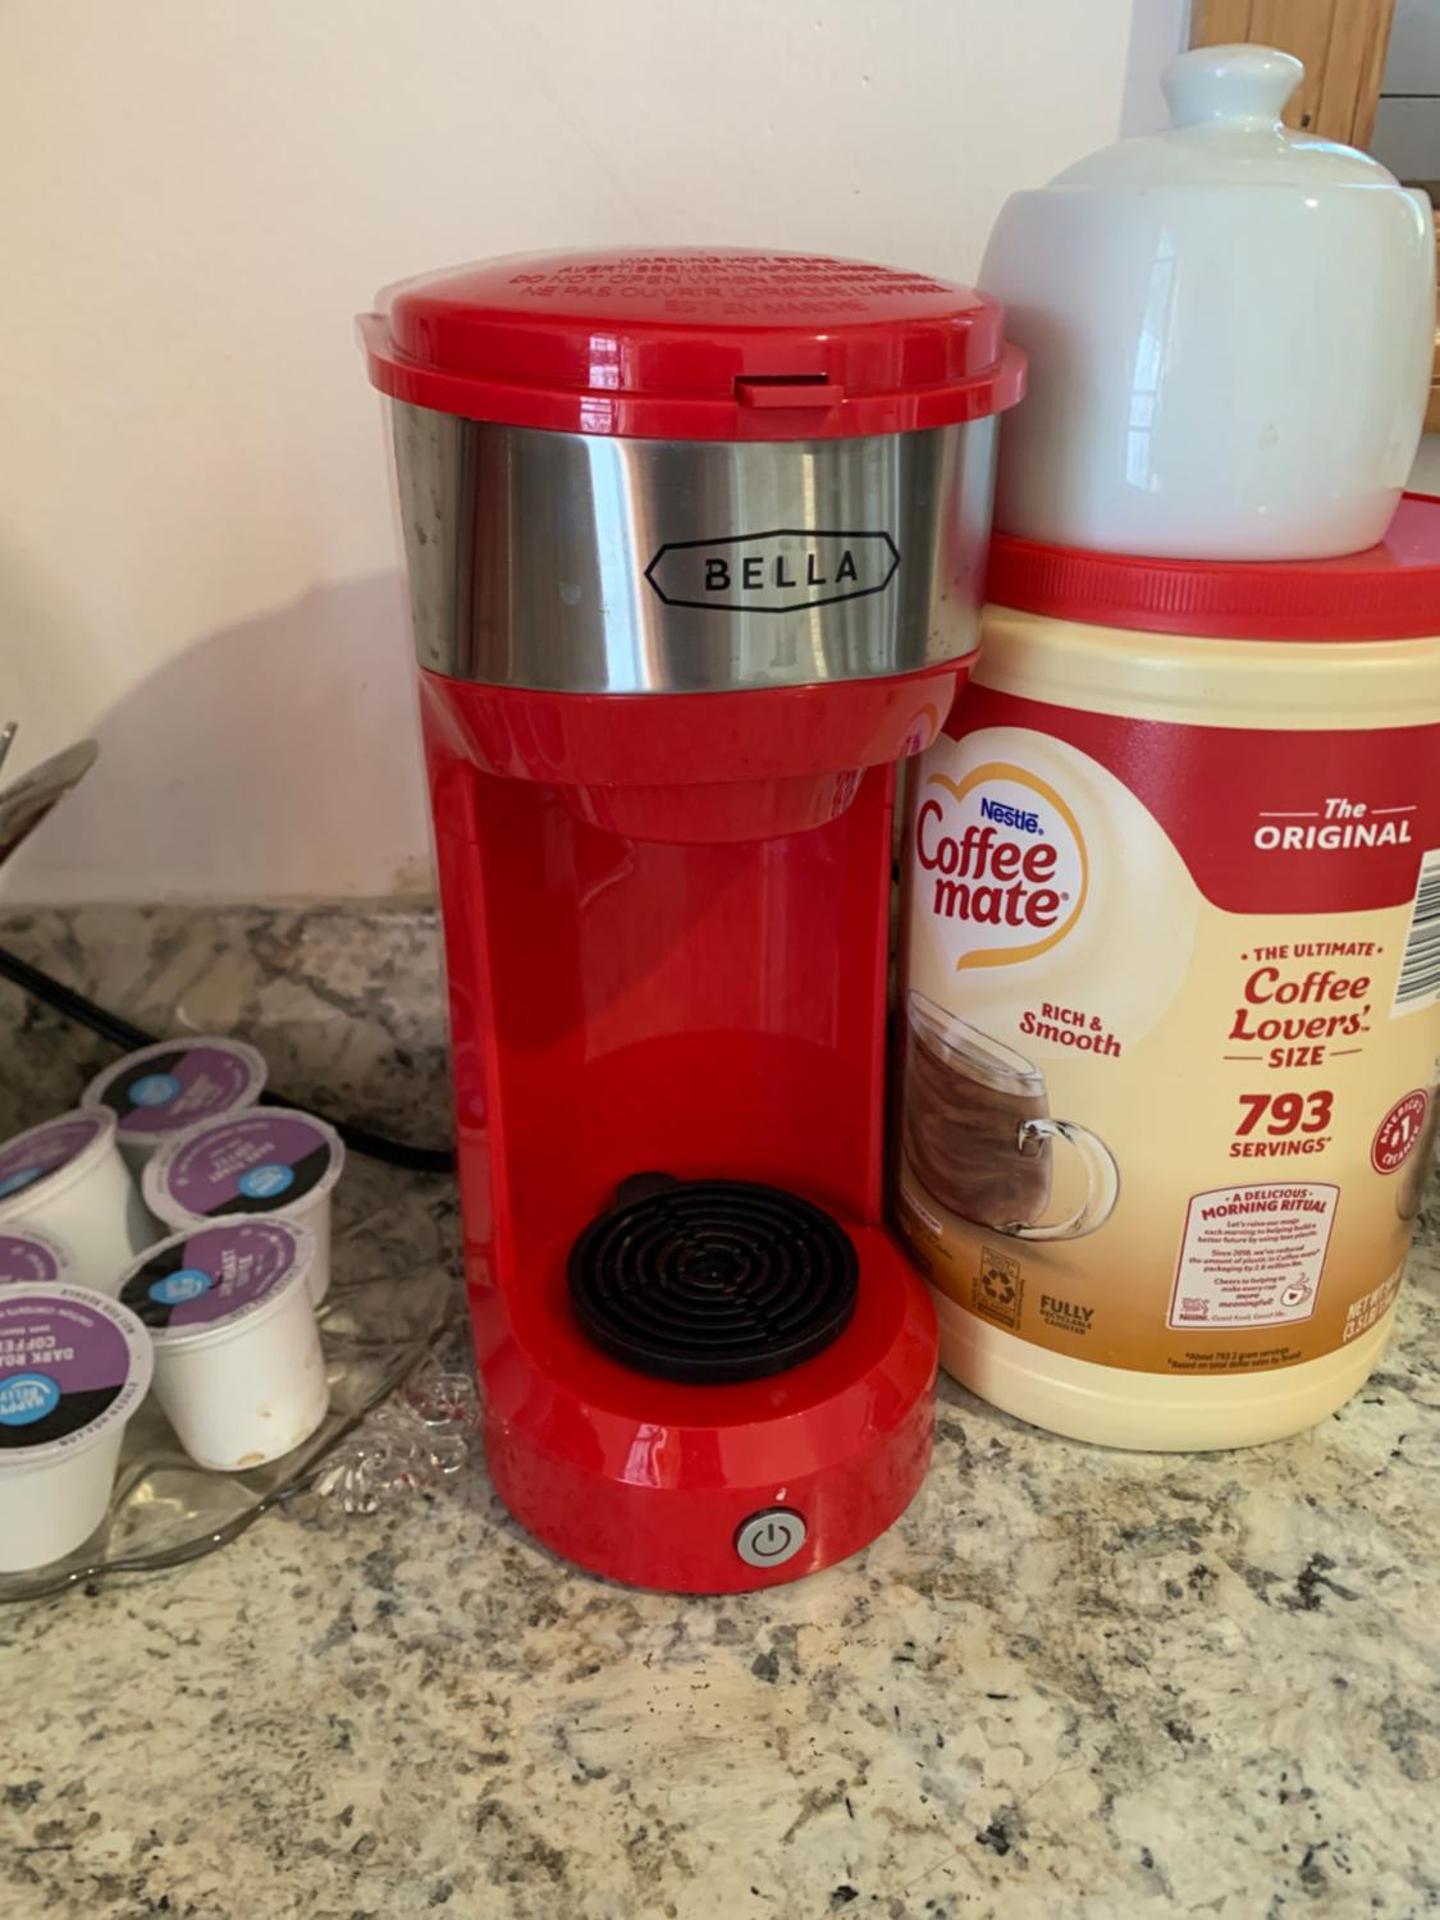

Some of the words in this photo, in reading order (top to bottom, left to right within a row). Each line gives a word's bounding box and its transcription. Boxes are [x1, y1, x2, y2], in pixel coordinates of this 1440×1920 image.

[508, 274, 546, 285] DO
[548, 274, 604, 285] NOT
[608, 274, 681, 285] OPEN
[687, 275, 768, 285] WHEN
[517, 286, 559, 297] NE
[560, 286, 612, 298] PAS
[620, 286, 723, 299] OUVRIR
[721, 301, 758, 315] EN
[704, 550, 858, 592] BELLA
[1324, 798, 1367, 820] The
[916, 799, 1058, 884] Coffee
[1253, 820, 1412, 850] ORIGINAL
[933, 878, 1061, 928] mate
[1253, 945, 1289, 962] THE
[1293, 942, 1376, 959] ULTIMATE
[1244, 966, 1371, 1005] Coffee
[1041, 1002, 1086, 1028] RICH
[1089, 1015, 1103, 1032] &
[1019, 1011, 1122, 1058] Smooth
[1268, 1045, 1325, 1069] SIZE
[1235, 1090, 1334, 1136] 793
[1233, 1193, 1242, 1202] A
[1244, 1188, 1309, 1201] DELICIOUS
[1201, 1200, 1278, 1221] MORNING
[1280, 1199, 1328, 1214] RITUAL
[1041, 1294, 1095, 1322] FULLY
[31, 1347, 75, 1366] DARK
